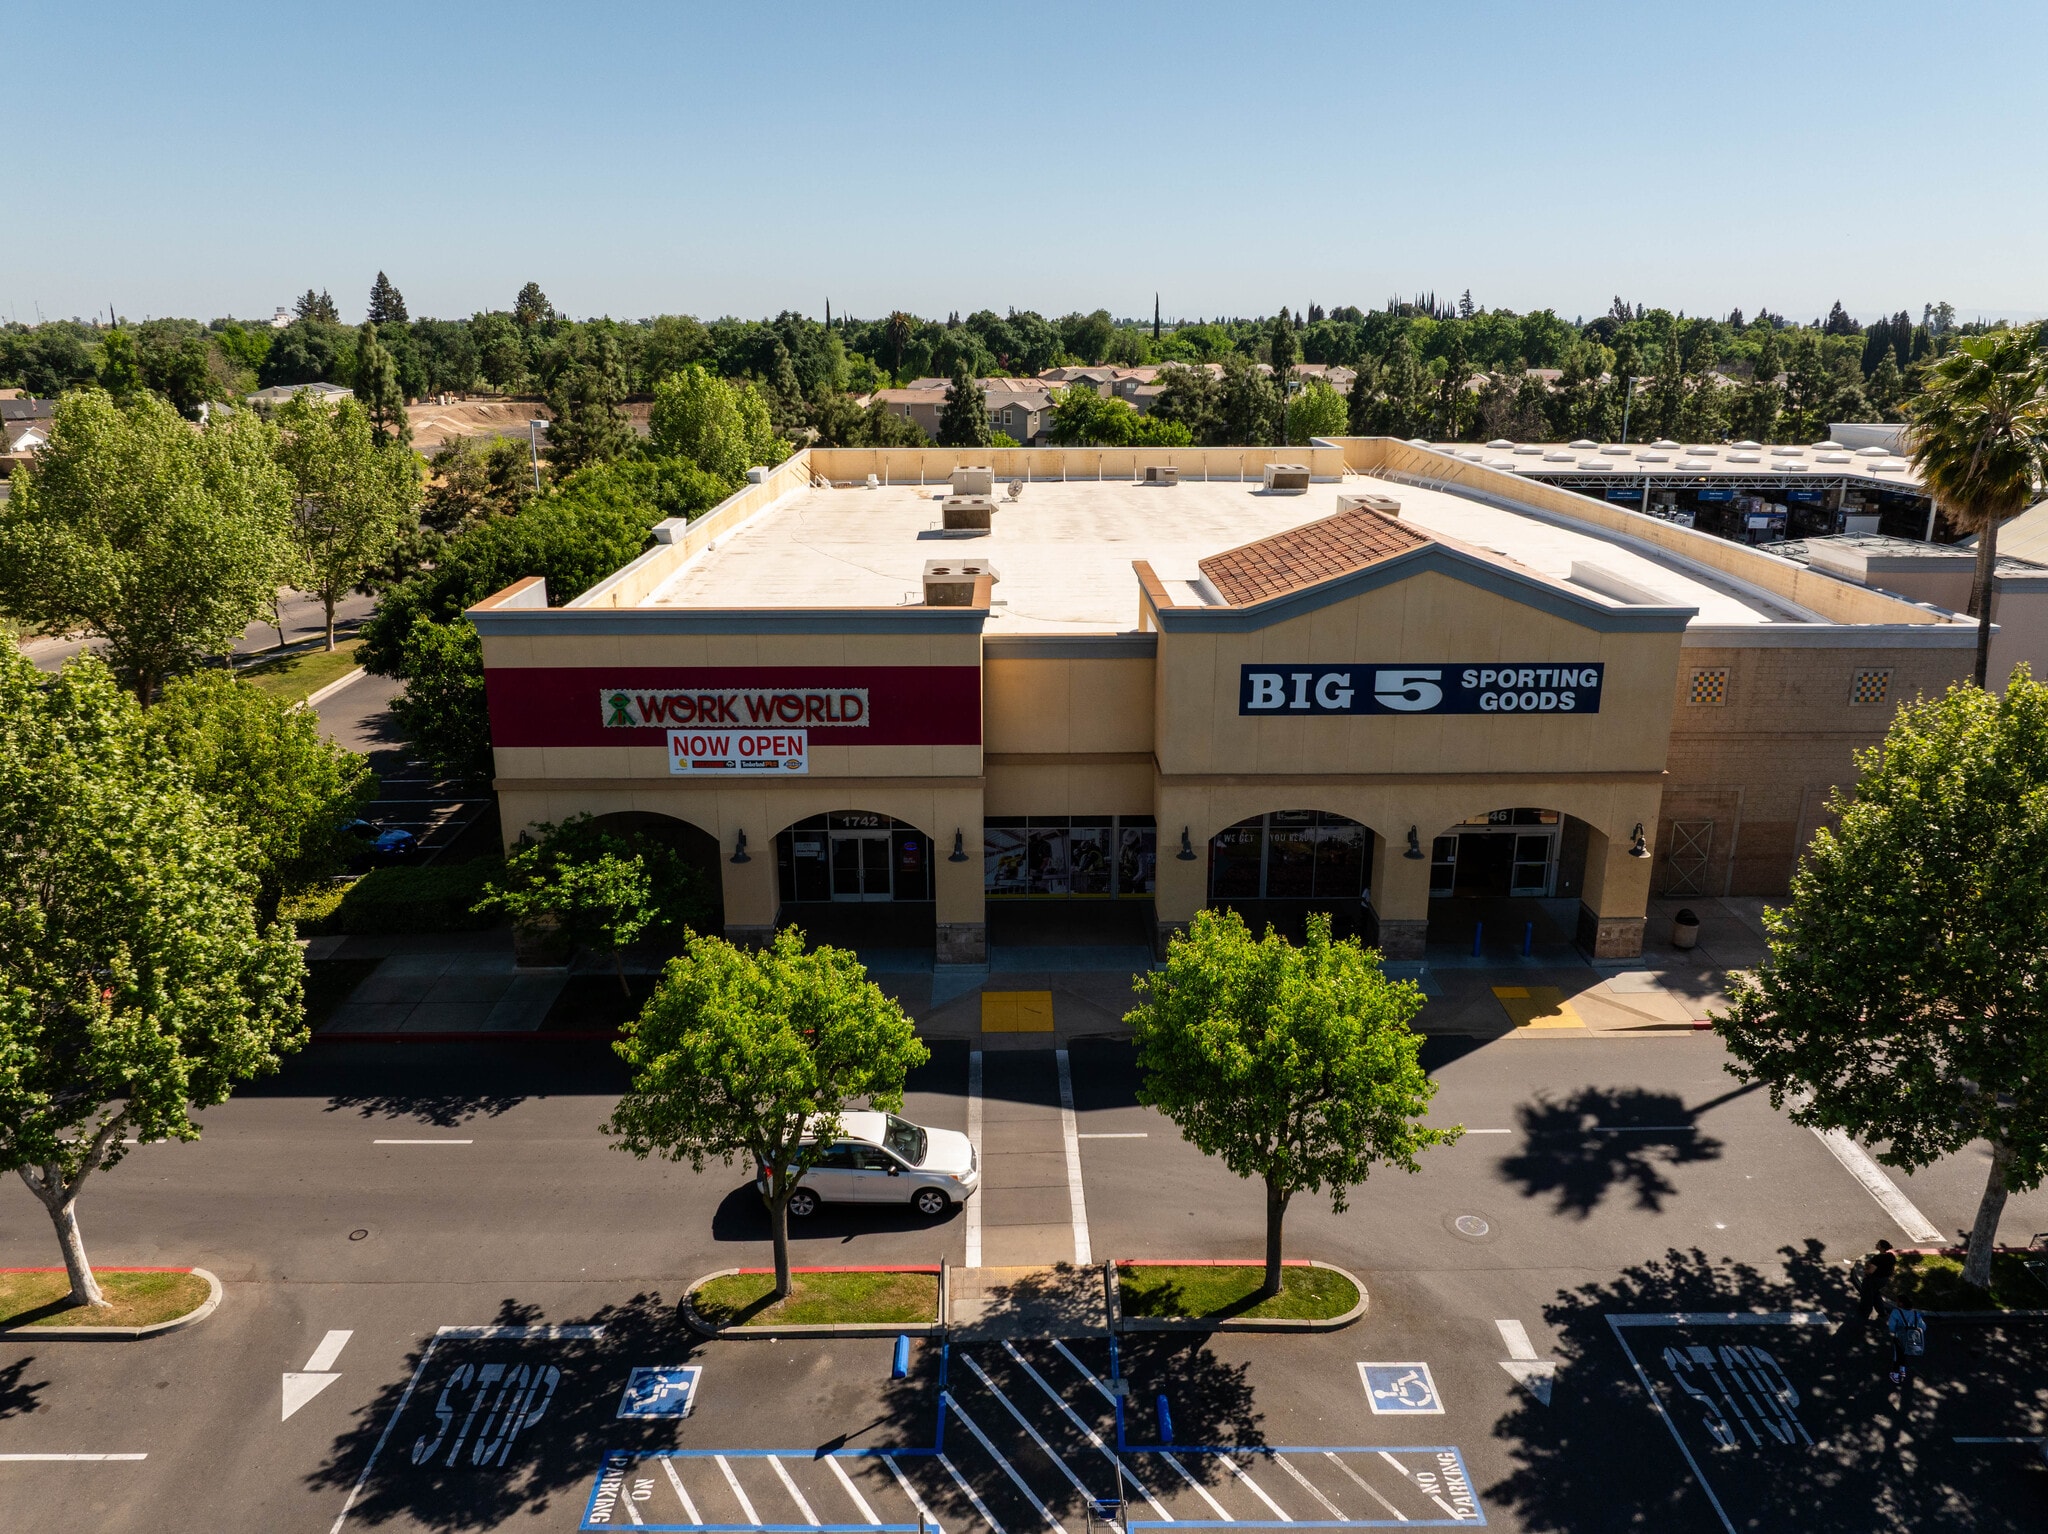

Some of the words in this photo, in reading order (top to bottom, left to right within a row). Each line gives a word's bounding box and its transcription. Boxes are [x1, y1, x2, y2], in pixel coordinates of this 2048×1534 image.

[1247, 672, 1355, 709] BIG
[1373, 670, 1443, 711] 5
[1461, 668, 1598, 689] SPORTING
[1479, 691, 1576, 711] GOODS
[635, 694, 739, 723] WORK
[744, 694, 864, 723] WORLD
[673, 735, 730, 756] NOW
[738, 735, 803, 756] OPEN
[842, 816, 878, 826] 1742
[1269, 833, 1287, 842] YOU
[1663, 1346, 1815, 1447] STOP
[411, 1363, 561, 1467] STOP
[588, 1456, 628, 1525] PARKING
[631, 1477, 655, 1502] NO
[1419, 1471, 1441, 1495] NO
[1437, 1452, 1479, 1520] PARKING
